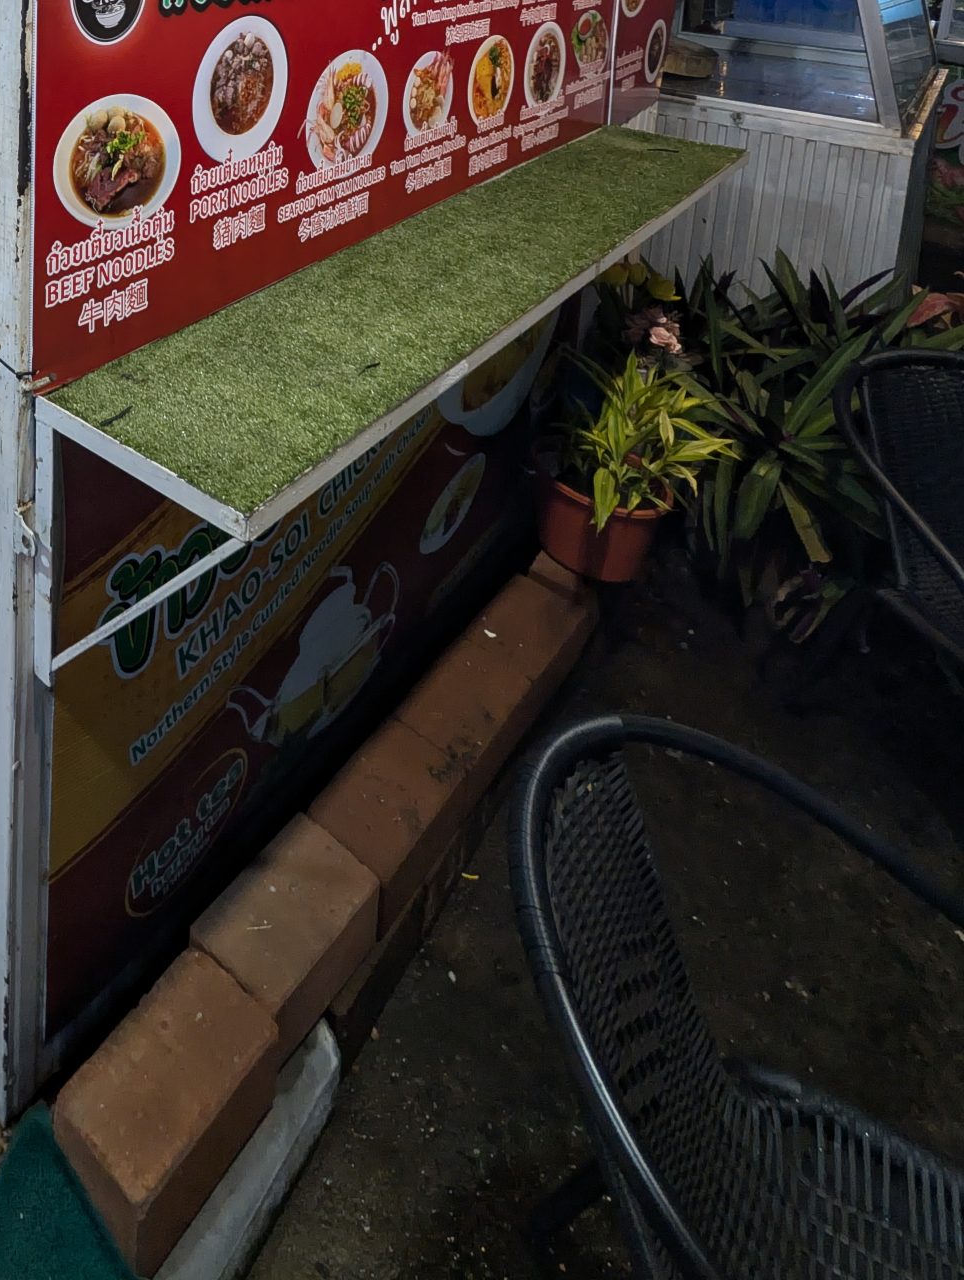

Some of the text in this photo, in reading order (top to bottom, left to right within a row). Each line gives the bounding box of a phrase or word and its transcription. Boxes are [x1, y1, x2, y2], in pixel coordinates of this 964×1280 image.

[411, 12, 427, 27] Tom
[189, 167, 289, 224] PORK NOODLES
[277, 165, 386, 223] SEAFOOD TOM YAM NOODLES
[389, 160, 406, 177] Tom
[405, 153, 421, 170] Yum
[46, 205, 176, 276] ก๋วยเตี๋ยวเนื้อตุ๋น
[45, 237, 175, 309] BEEF NOODLES
[78, 278, 149, 333] 牛肉麵
[128, 404, 433, 767] Northern Style Curried Noodle Soup with Chicken
[175, 515, 312, 679] KHAO-SOI
[130, 818, 192, 900] Hot
[196, 758, 244, 822] tea
